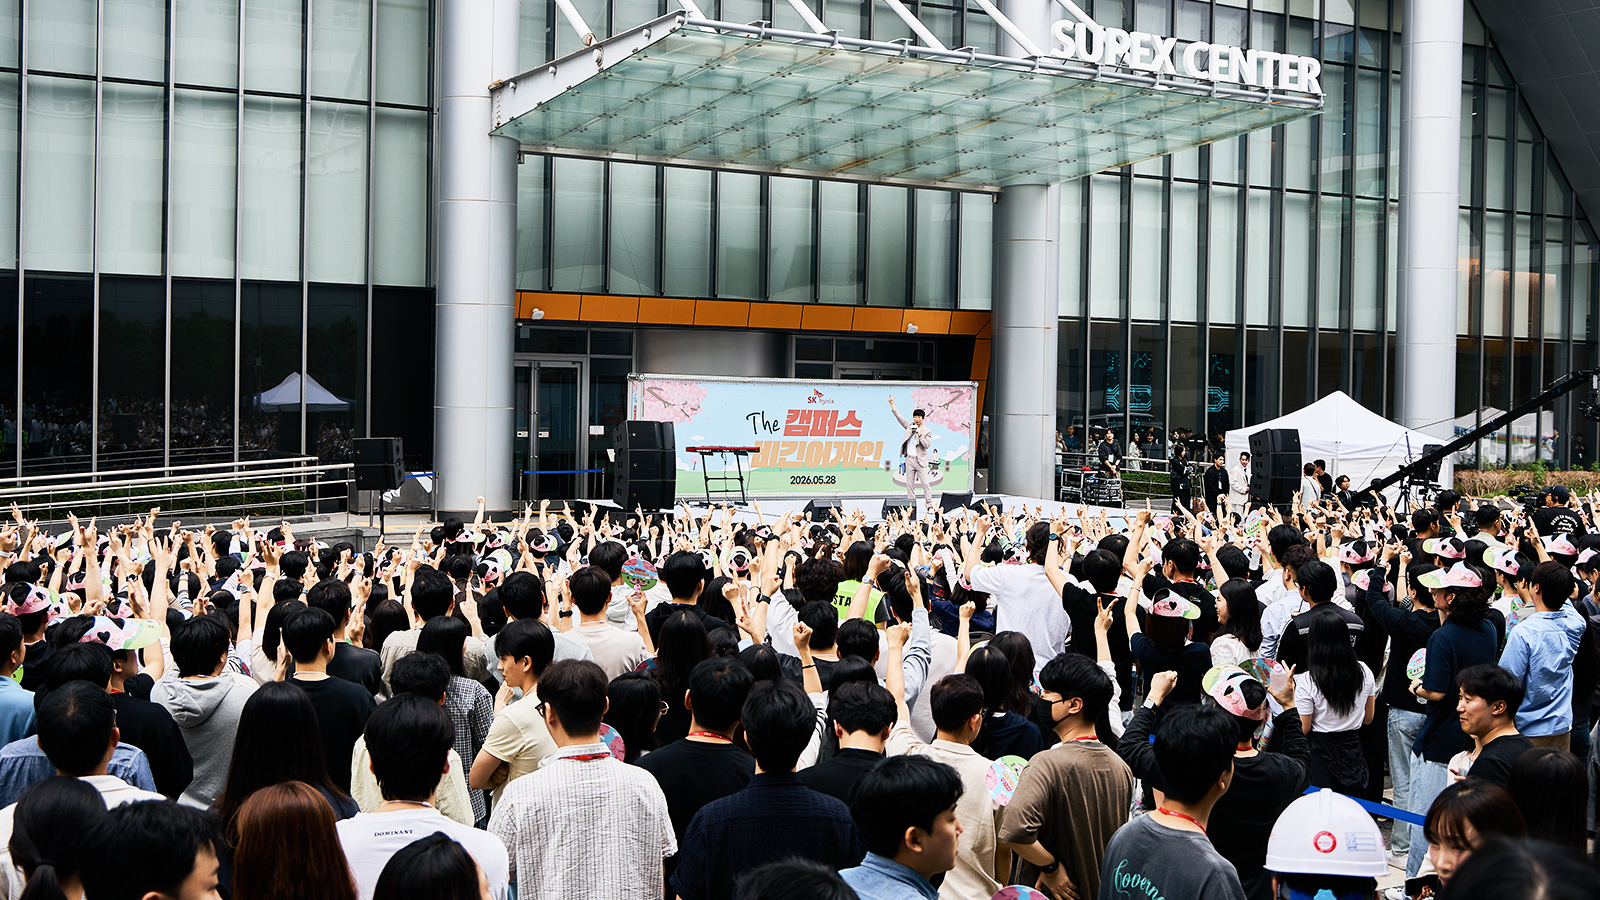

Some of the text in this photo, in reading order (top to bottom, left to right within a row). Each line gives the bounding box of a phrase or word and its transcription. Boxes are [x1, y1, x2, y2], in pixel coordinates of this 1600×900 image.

[1050, 20, 1322, 94] SUPEX CENTER
[807, 396, 817, 404] SK
[746, 409, 863, 437] The 캠퍼스
[750, 440, 884, 468] 비긴어게인
[790, 475, 837, 485] 2026.05.28
[833, 594, 852, 607] STA
[374, 829, 414, 837] DOMINANT
[1110, 858, 1165, 900] Govern
